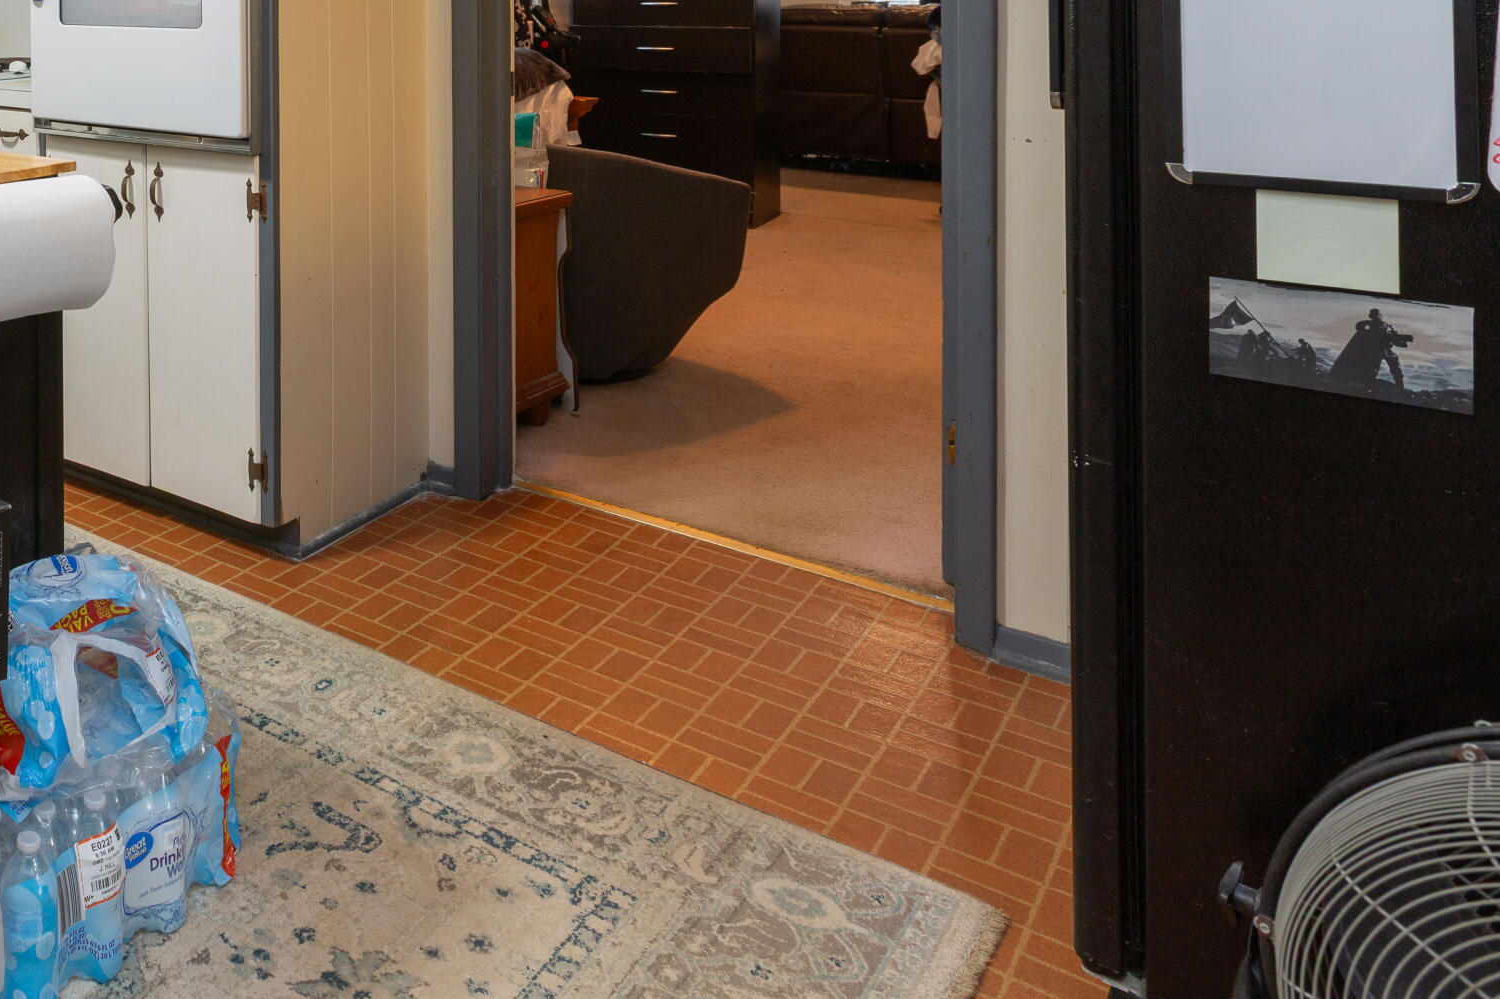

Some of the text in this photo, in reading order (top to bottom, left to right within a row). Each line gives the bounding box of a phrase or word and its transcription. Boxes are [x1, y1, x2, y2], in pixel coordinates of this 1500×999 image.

[91, 836, 113, 852] E0227
[125, 836, 147, 859] Great
[128, 847, 147, 863] Value
[150, 846, 184, 872] Drink
